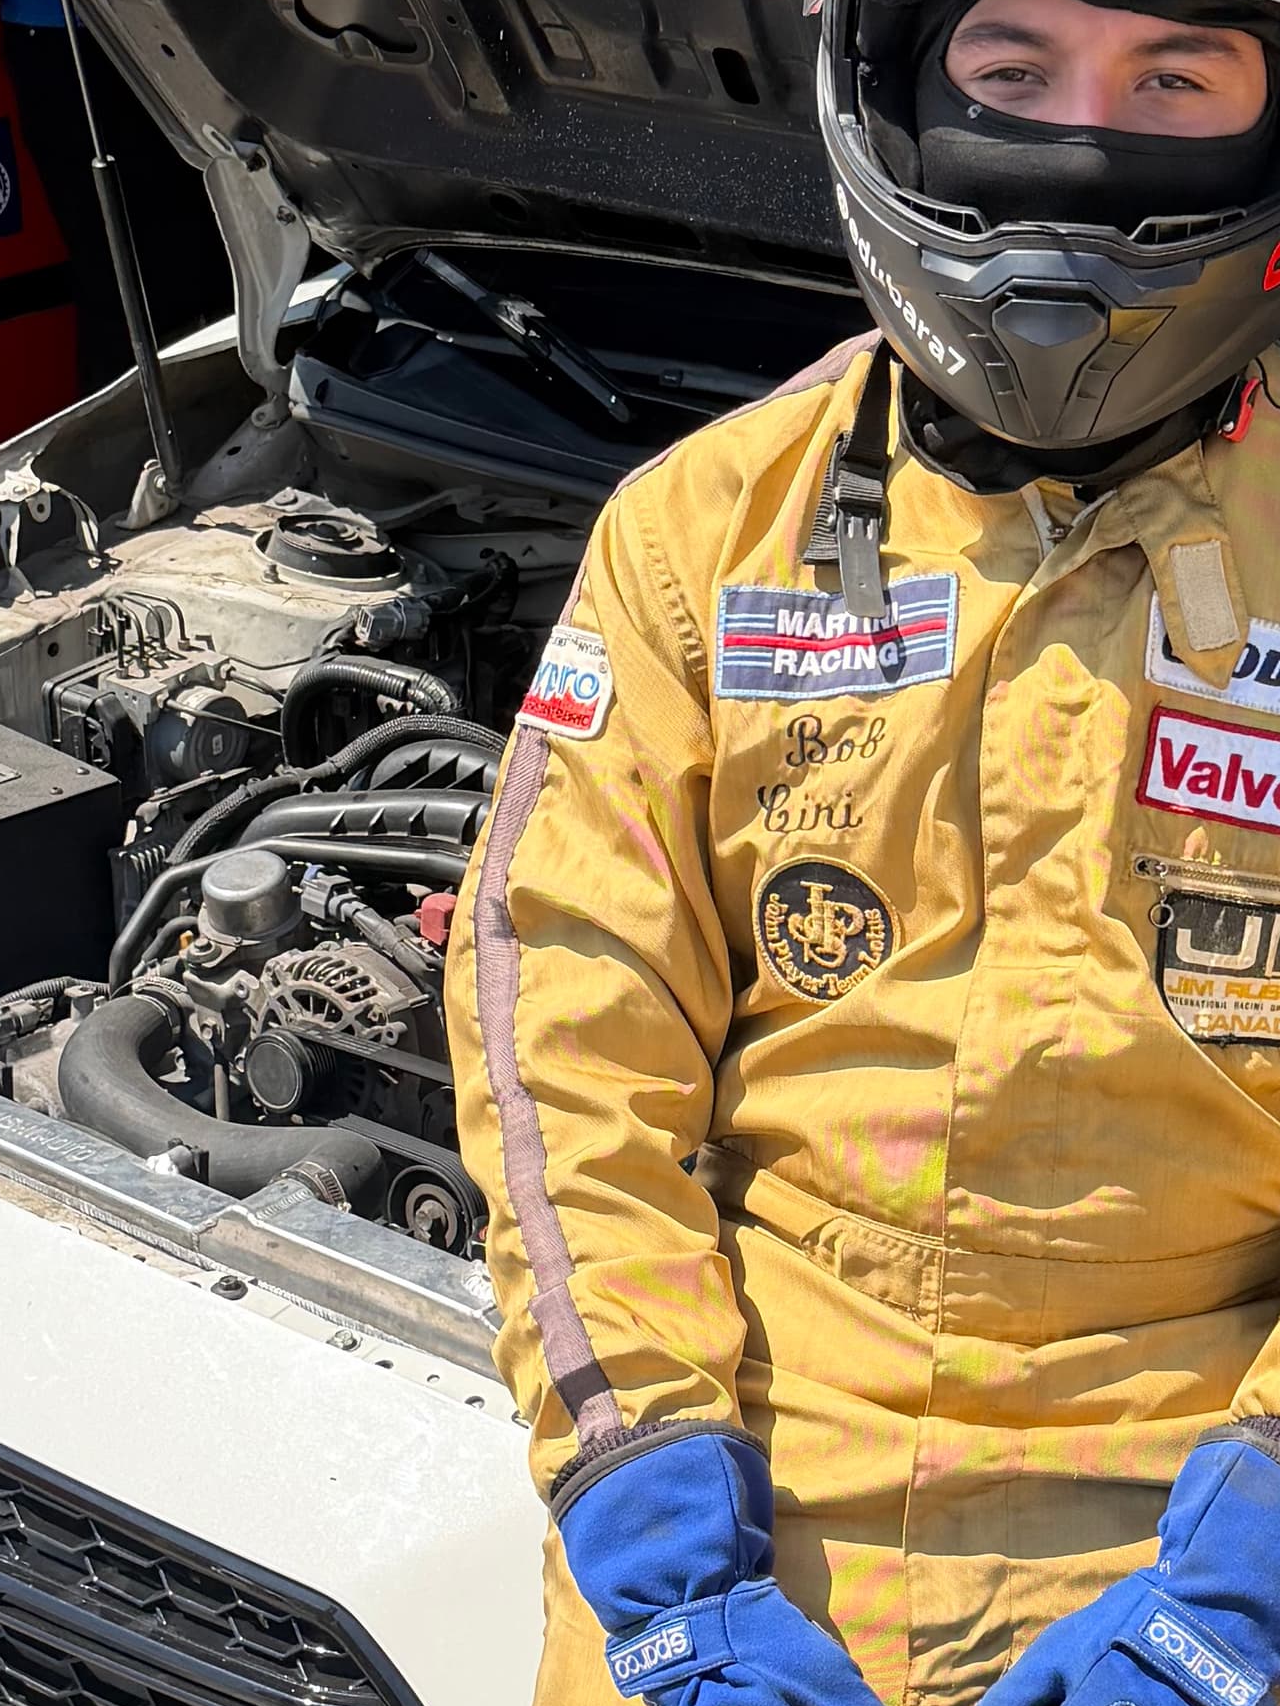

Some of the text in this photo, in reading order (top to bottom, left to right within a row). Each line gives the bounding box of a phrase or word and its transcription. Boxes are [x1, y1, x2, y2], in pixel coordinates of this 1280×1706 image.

[835, 182, 967, 378] @edubara7
[773, 642, 900, 677] RACING
[786, 714, 886, 767] Bob
[1168, 977, 1214, 997] JIM
[611, 1622, 687, 1679] sparco
[1148, 1613, 1257, 1706] sparco
